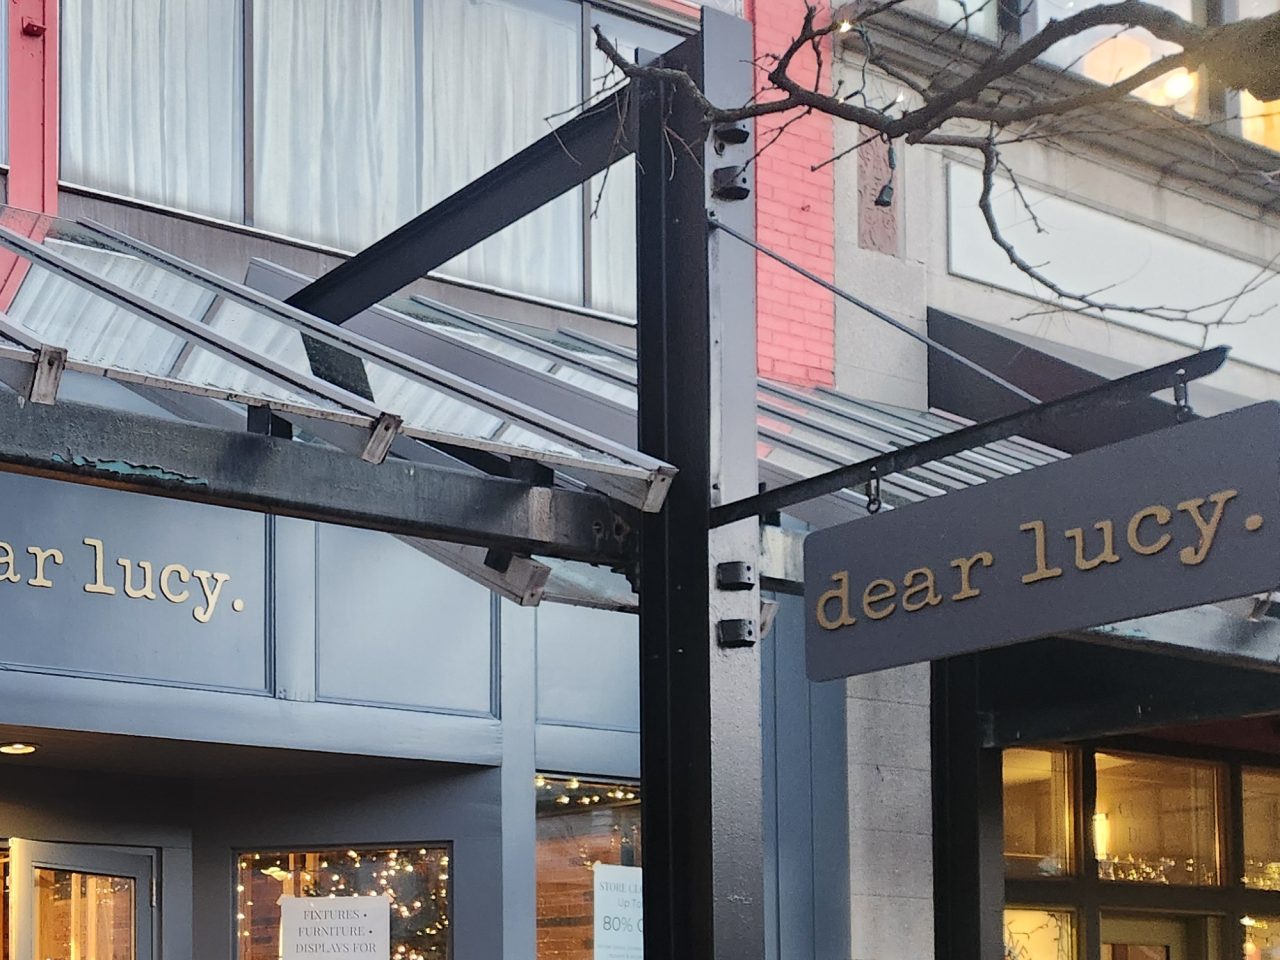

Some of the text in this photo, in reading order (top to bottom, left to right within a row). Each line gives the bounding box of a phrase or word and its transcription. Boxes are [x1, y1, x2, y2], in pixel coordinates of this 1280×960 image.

[816, 489, 1264, 631] dear lucy.
[83, 537, 246, 624] lucy.
[599, 881, 626, 893] STORE
[617, 898, 630, 909] Up
[304, 909, 360, 921] FIXTURES
[603, 915, 633, 932] 80%
[298, 926, 366, 937] FURNITURE
[296, 943, 376, 953] DISPLAYS FOR
